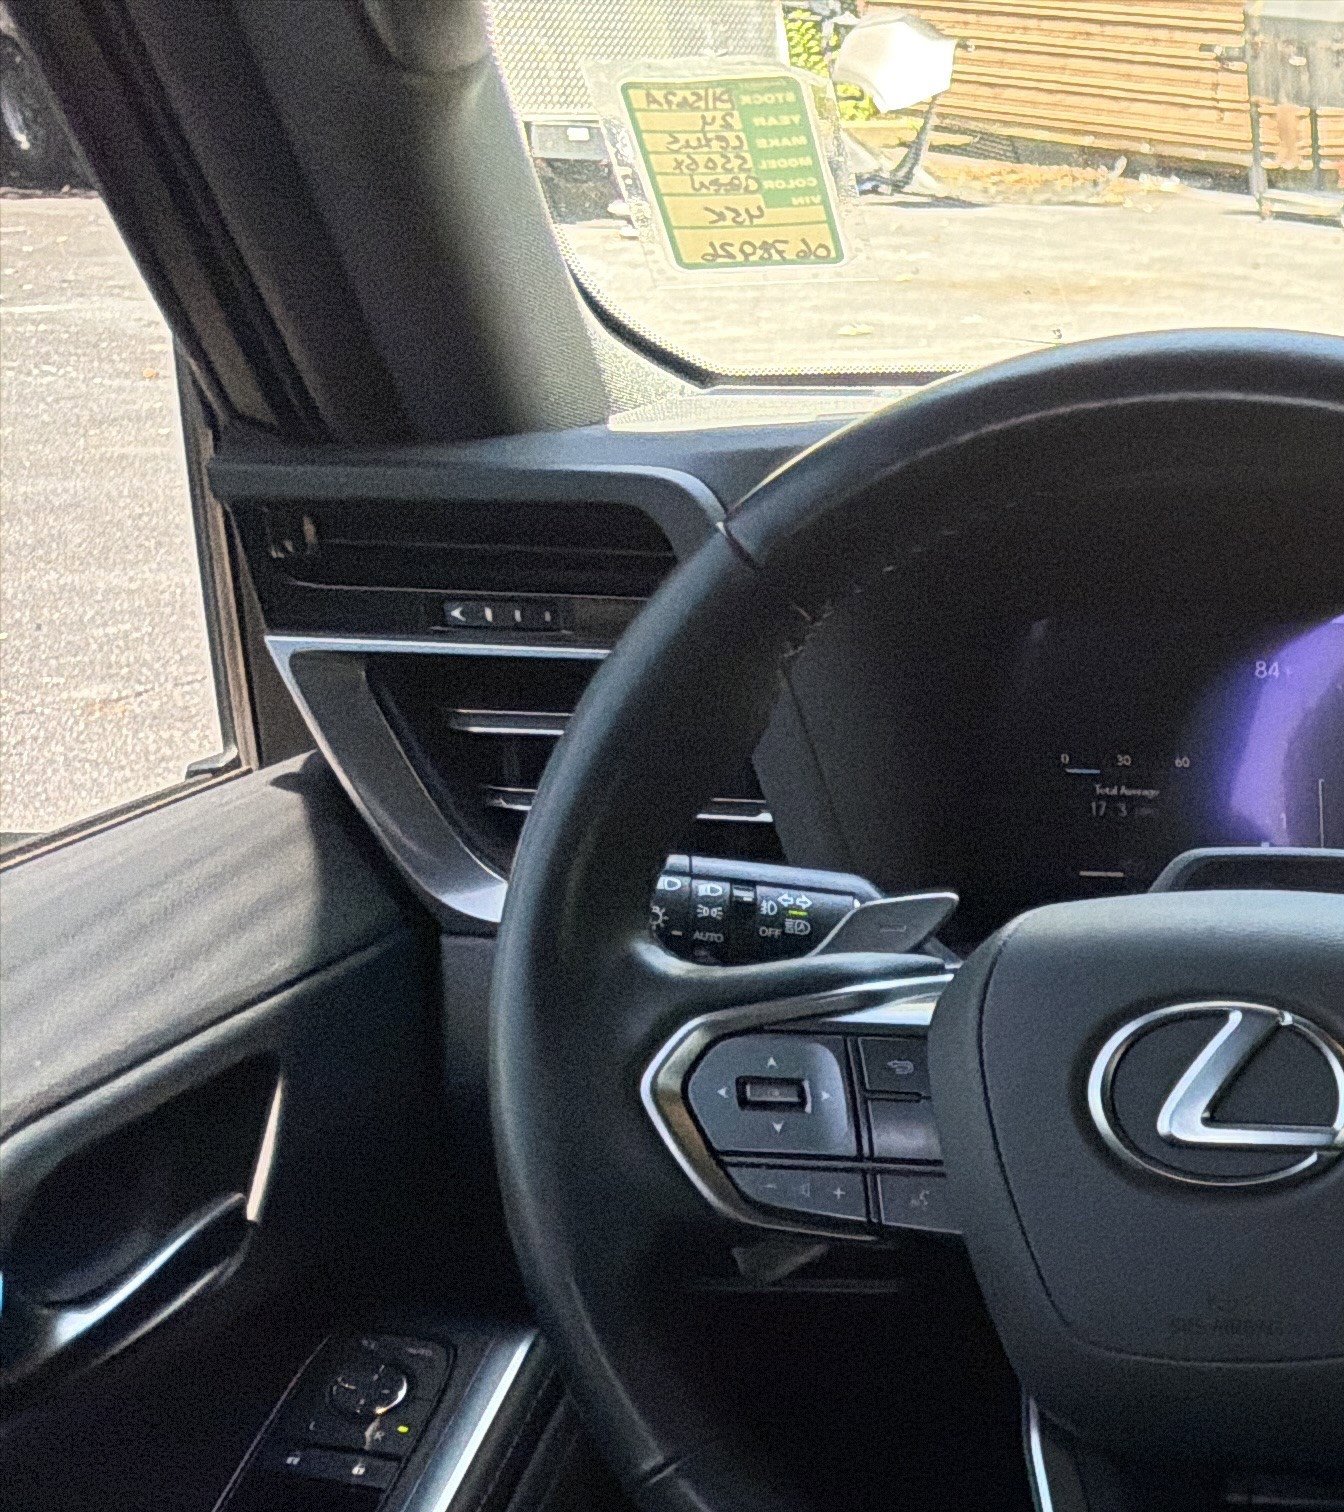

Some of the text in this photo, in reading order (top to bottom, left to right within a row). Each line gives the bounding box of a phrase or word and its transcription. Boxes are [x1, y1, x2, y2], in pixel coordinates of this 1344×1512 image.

[1254, 660, 1280, 679] 84
[1060, 753, 1069, 765] 0
[1116, 754, 1132, 767] 30
[1174, 756, 1190, 768] 60
[693, 930, 725, 943] AUTO
[759, 926, 782, 939] OFF
